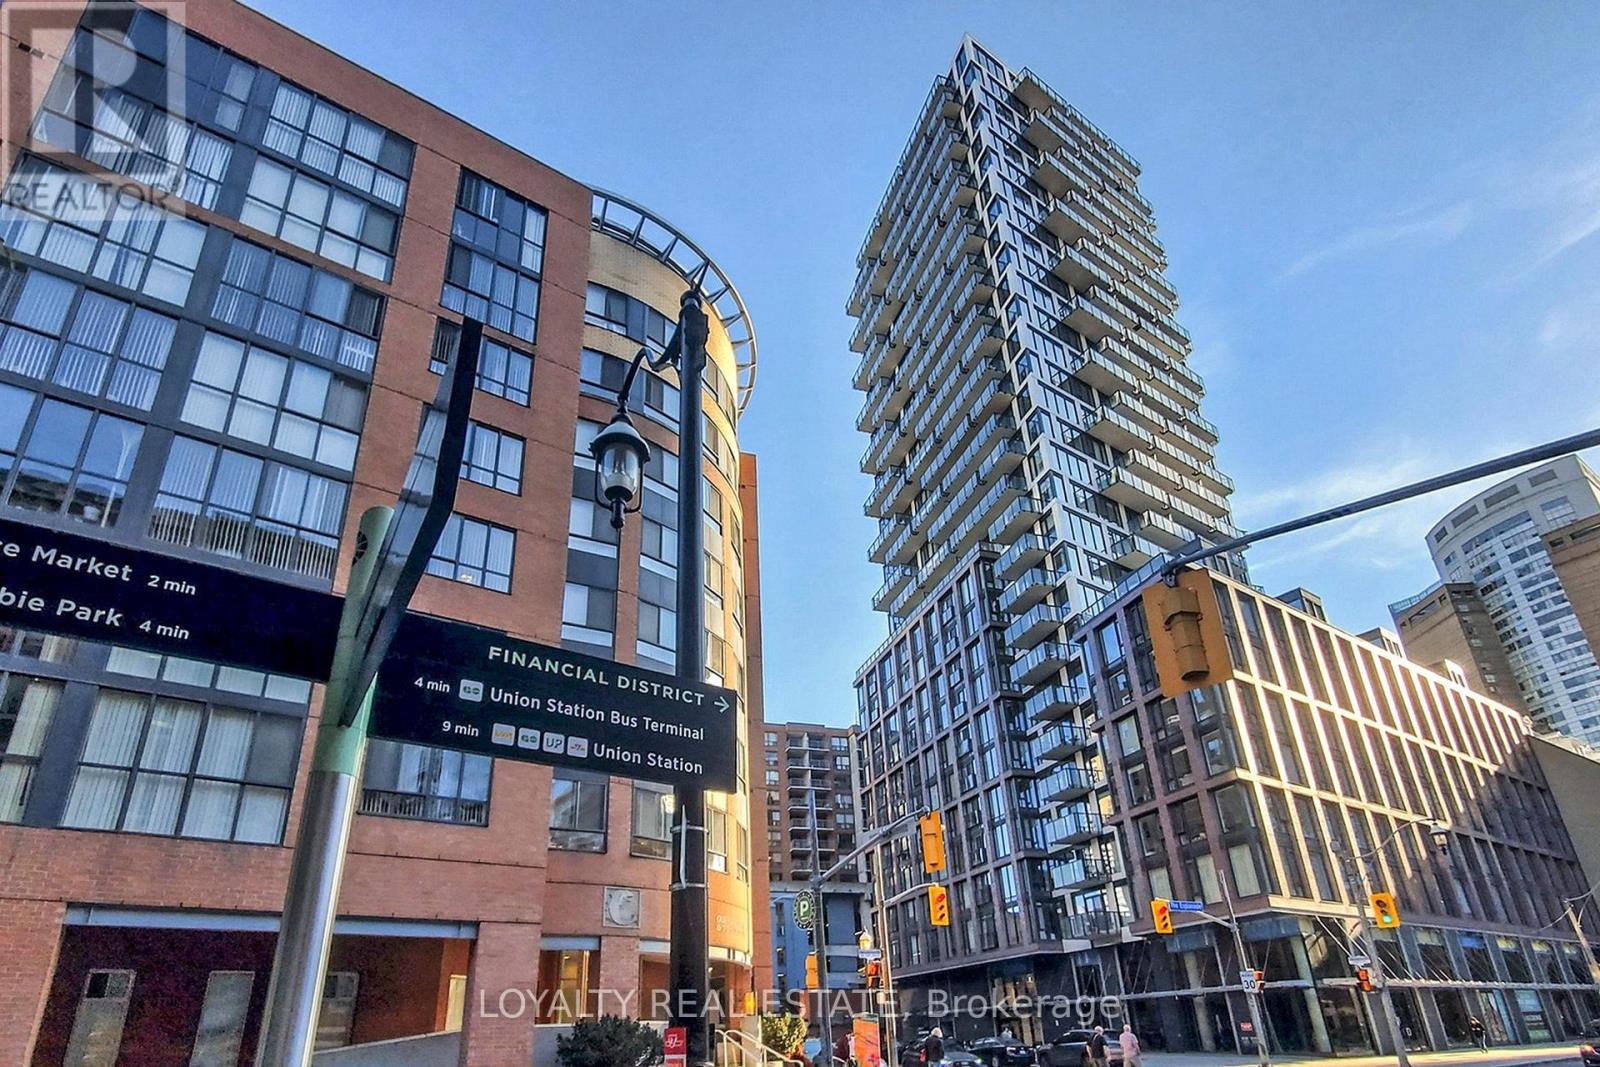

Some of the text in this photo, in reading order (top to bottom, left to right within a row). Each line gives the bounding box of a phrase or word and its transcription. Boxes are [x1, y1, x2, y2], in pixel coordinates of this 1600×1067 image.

[31, 544, 133, 582] Market
[147, 574, 160, 588] 2
[163, 579, 197, 596] min
[56, 598, 124, 627] Park
[139, 620, 152, 632] 4
[156, 624, 190, 640] min
[488, 646, 705, 706] FINANCIAL DISTRICT
[413, 676, 424, 688] 4
[426, 680, 451, 693] min
[490, 686, 541, 710] Union
[546, 698, 605, 722] Station
[610, 710, 638, 728] Bus
[642, 716, 705, 741] Terminal
[442, 720, 452, 732] 9
[454, 724, 480, 737] min
[593, 742, 641, 764] Union
[647, 752, 703, 775] Station
[800, 900, 809, 916] P
[1243, 979, 1256, 990] 30
